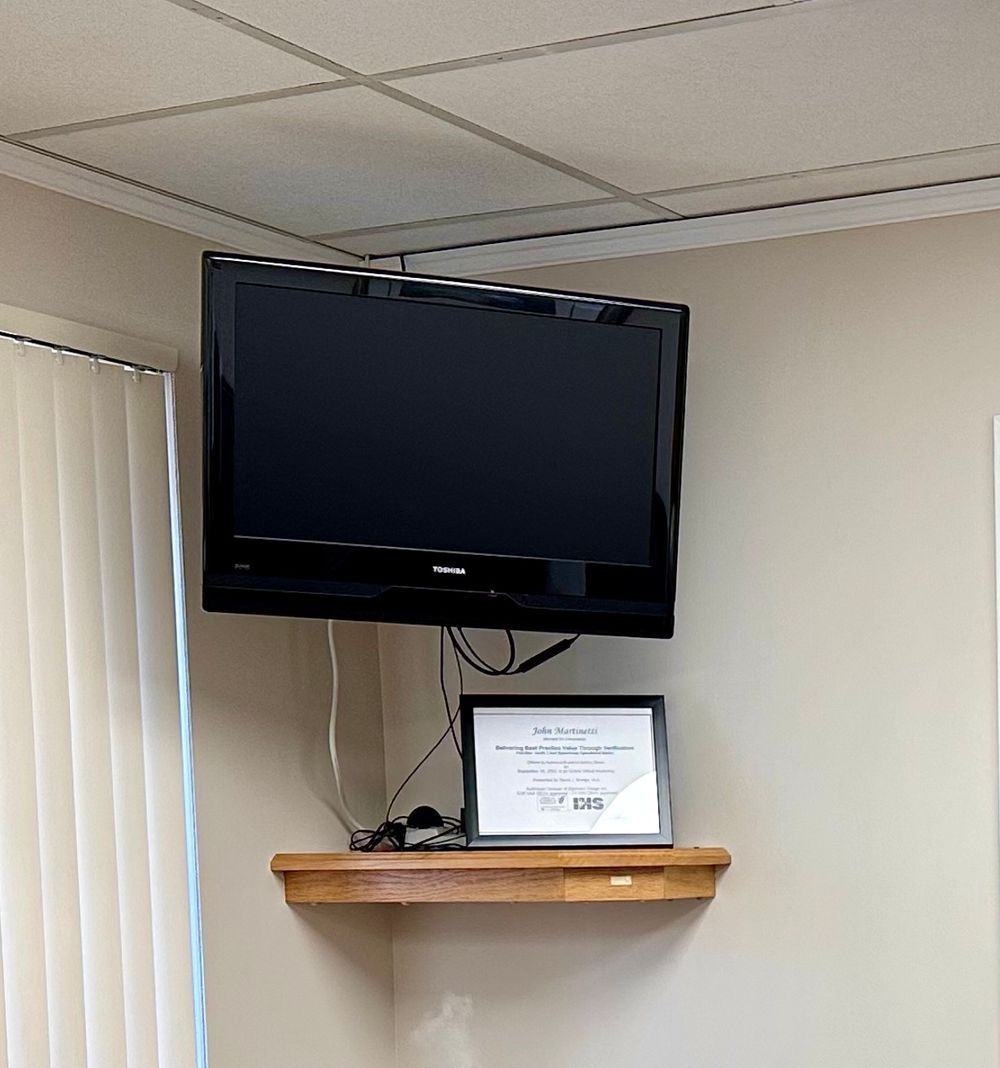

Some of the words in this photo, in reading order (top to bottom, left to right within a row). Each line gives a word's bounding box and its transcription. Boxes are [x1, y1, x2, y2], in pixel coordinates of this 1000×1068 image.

[432, 565, 466, 575] TOSHIBA
[532, 726, 552, 736] John
[554, 726, 598, 735] Martinetti
